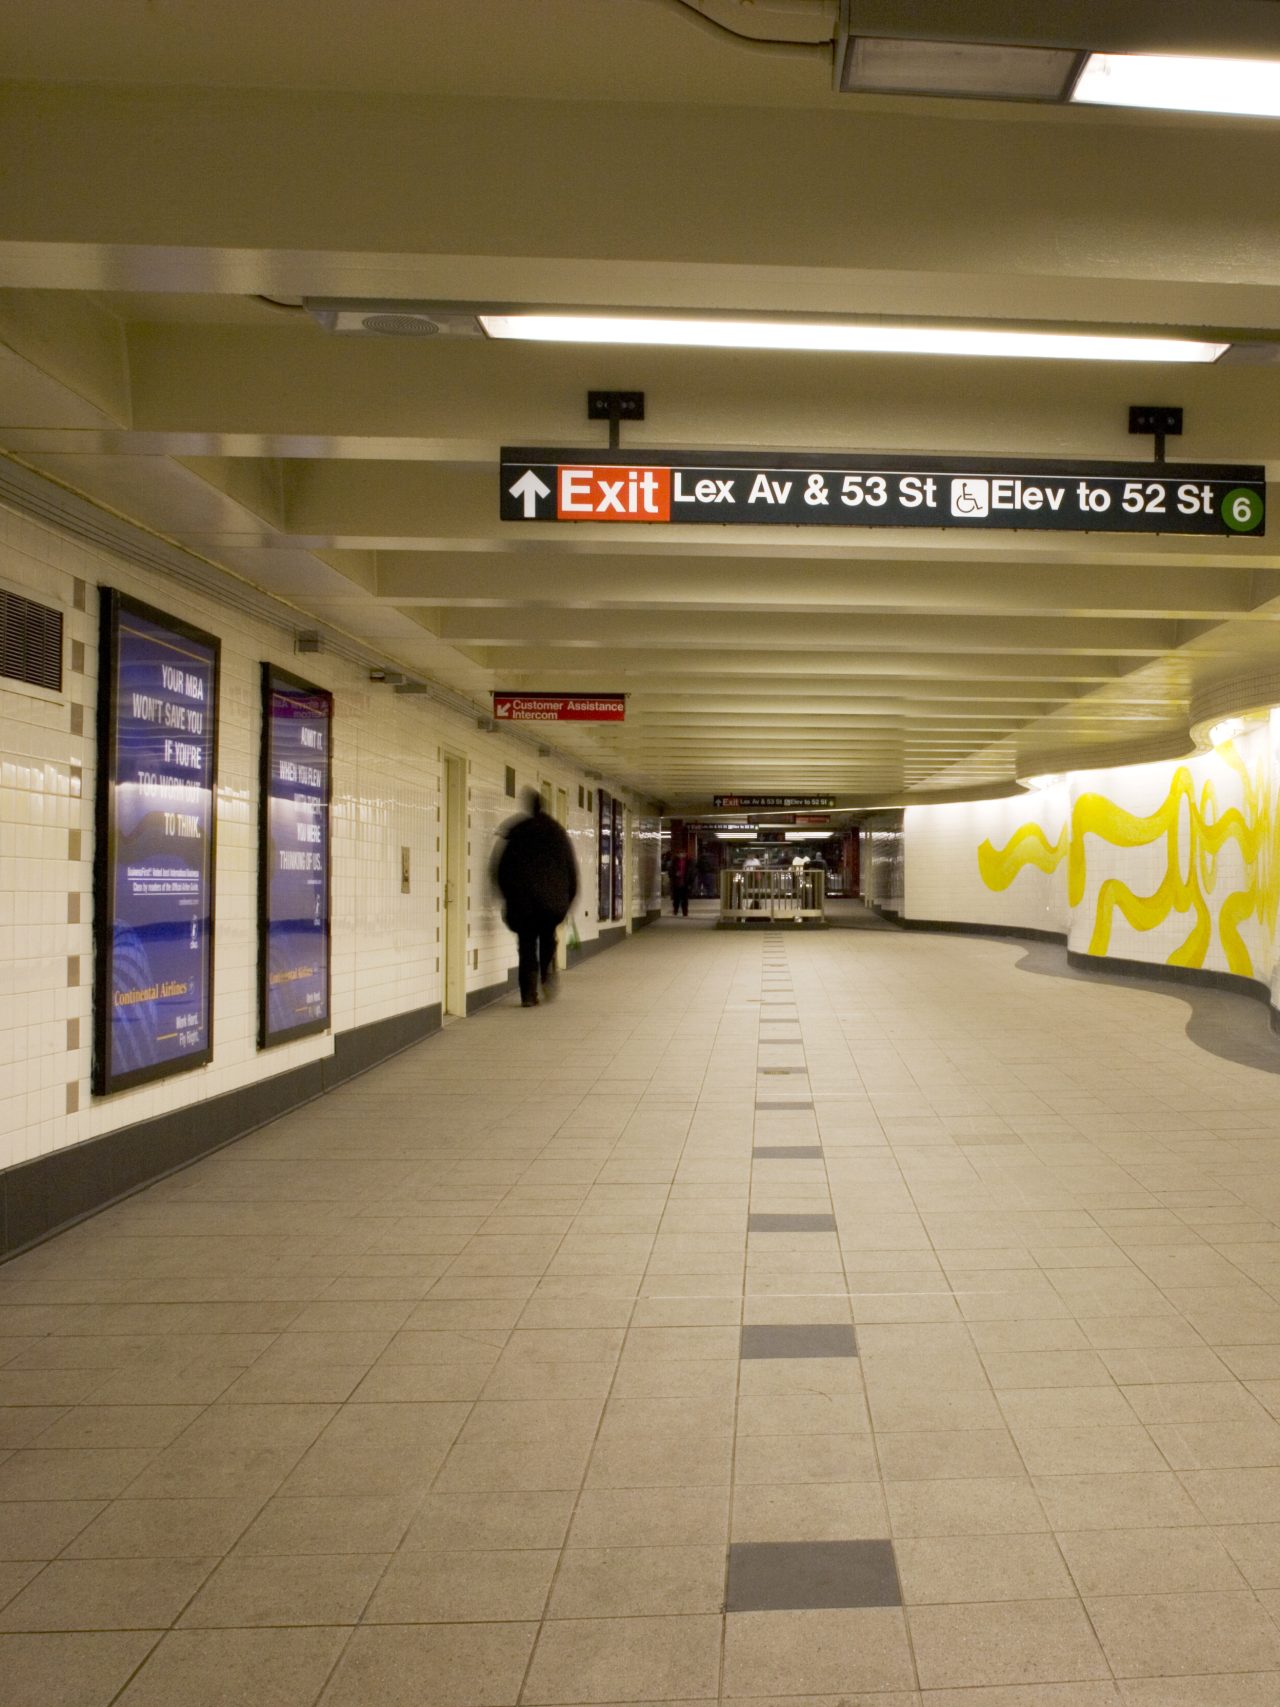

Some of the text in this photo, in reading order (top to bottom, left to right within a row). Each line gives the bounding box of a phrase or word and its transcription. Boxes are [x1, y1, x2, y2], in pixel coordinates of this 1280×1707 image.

[561, 470, 1251, 522] Exit Lex Av & 53 St Elev to 52 St 6
[162, 664, 203, 700] YOUR MBA
[132, 693, 203, 735] WON'T SAVE YOU
[512, 700, 624, 711] Customer Assistance
[512, 710, 558, 720] Intercom
[165, 739, 202, 769] IF YOU'RE
[138, 771, 157, 797] TOO
[723, 798, 738, 806] Exit
[164, 812, 201, 838] TO THINK.
[114, 980, 188, 1006] Continental Airlines
